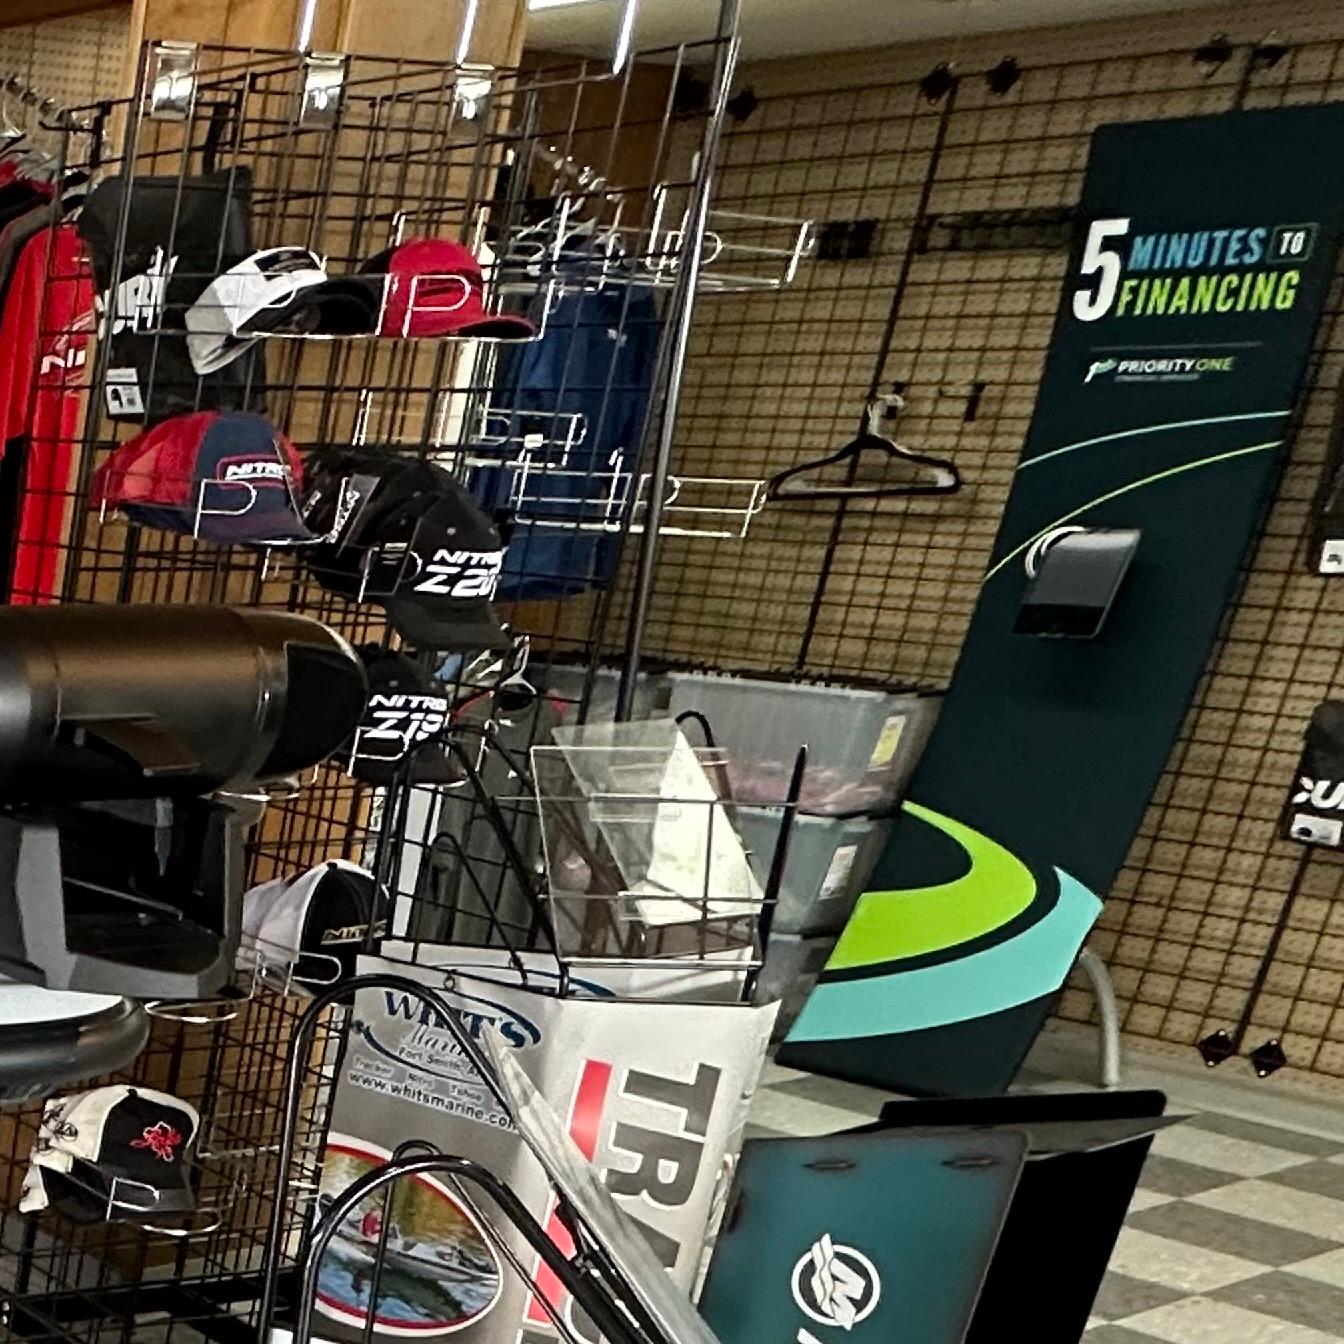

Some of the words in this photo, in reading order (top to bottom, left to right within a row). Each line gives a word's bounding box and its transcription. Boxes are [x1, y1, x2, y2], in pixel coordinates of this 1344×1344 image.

[1072, 217, 1131, 322] 5
[1127, 227, 1267, 272] MINUTES
[1279, 231, 1306, 256] TO
[1114, 269, 1300, 318] FINANCING
